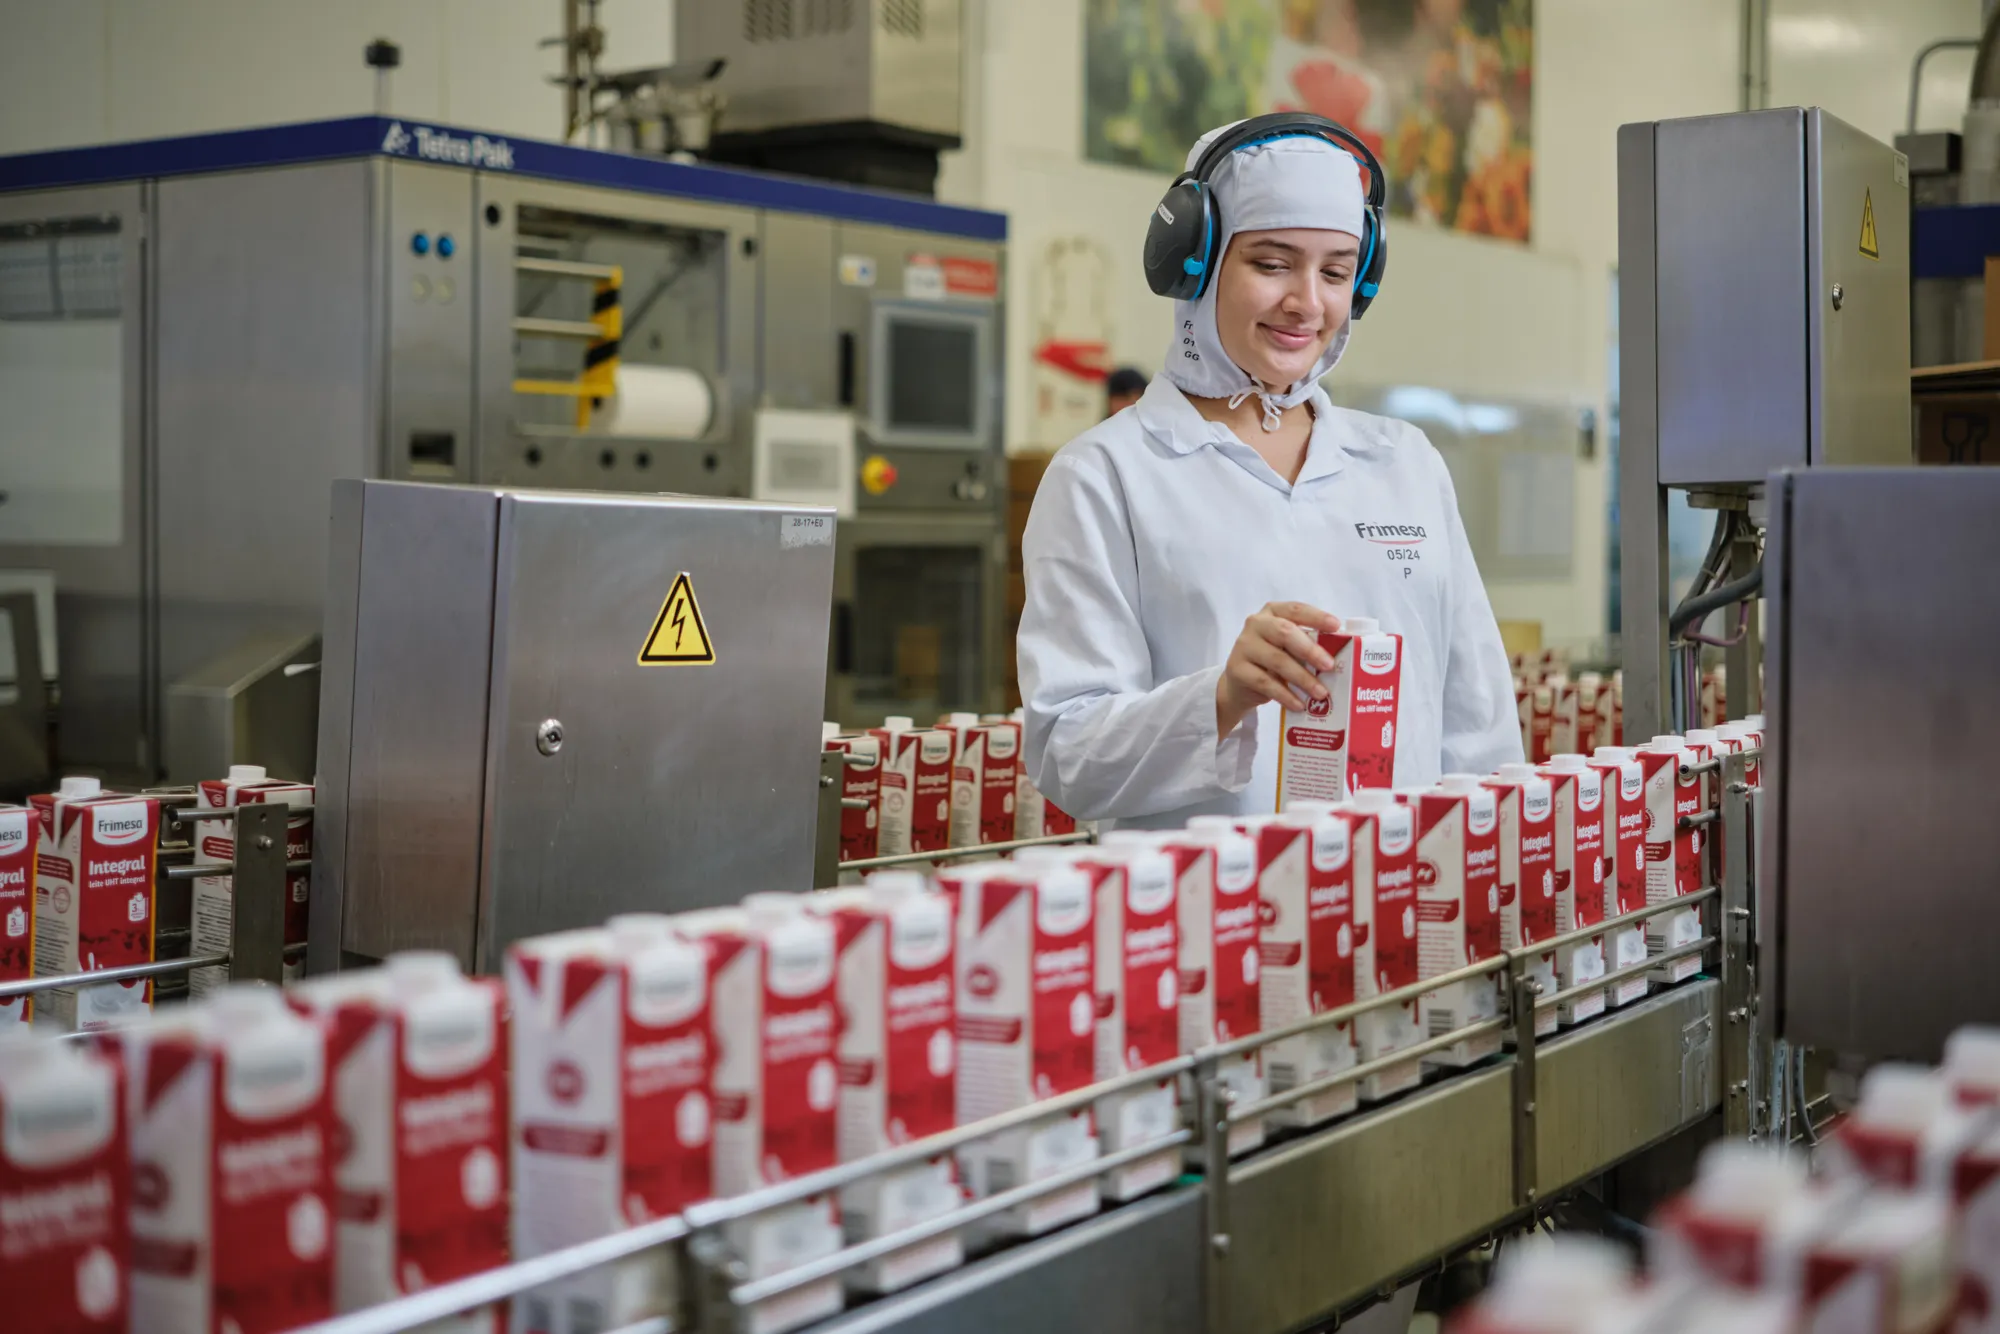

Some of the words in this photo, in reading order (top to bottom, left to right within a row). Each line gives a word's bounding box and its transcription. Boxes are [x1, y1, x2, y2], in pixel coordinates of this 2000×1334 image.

[413, 127, 470, 163] Tetra
[472, 135, 515, 169] Pak
[1184, 351, 1200, 361] GG
[1354, 522, 1428, 539] Frimesa
[1387, 548, 1421, 560] 05/24
[1403, 567, 1412, 579] P
[1363, 650, 1392, 661] Frimesa
[1357, 685, 1394, 704] Integral
[1677, 796, 1698, 814] Integral
[98, 819, 143, 832] Frimesa
[1620, 810, 1643, 829] Integral
[1577, 820, 1600, 840] Integral
[1522, 831, 1551, 852] Integral
[89, 855, 146, 876] Integral
[105, 877, 119, 887] UHT
[120, 875, 146, 885] integral
